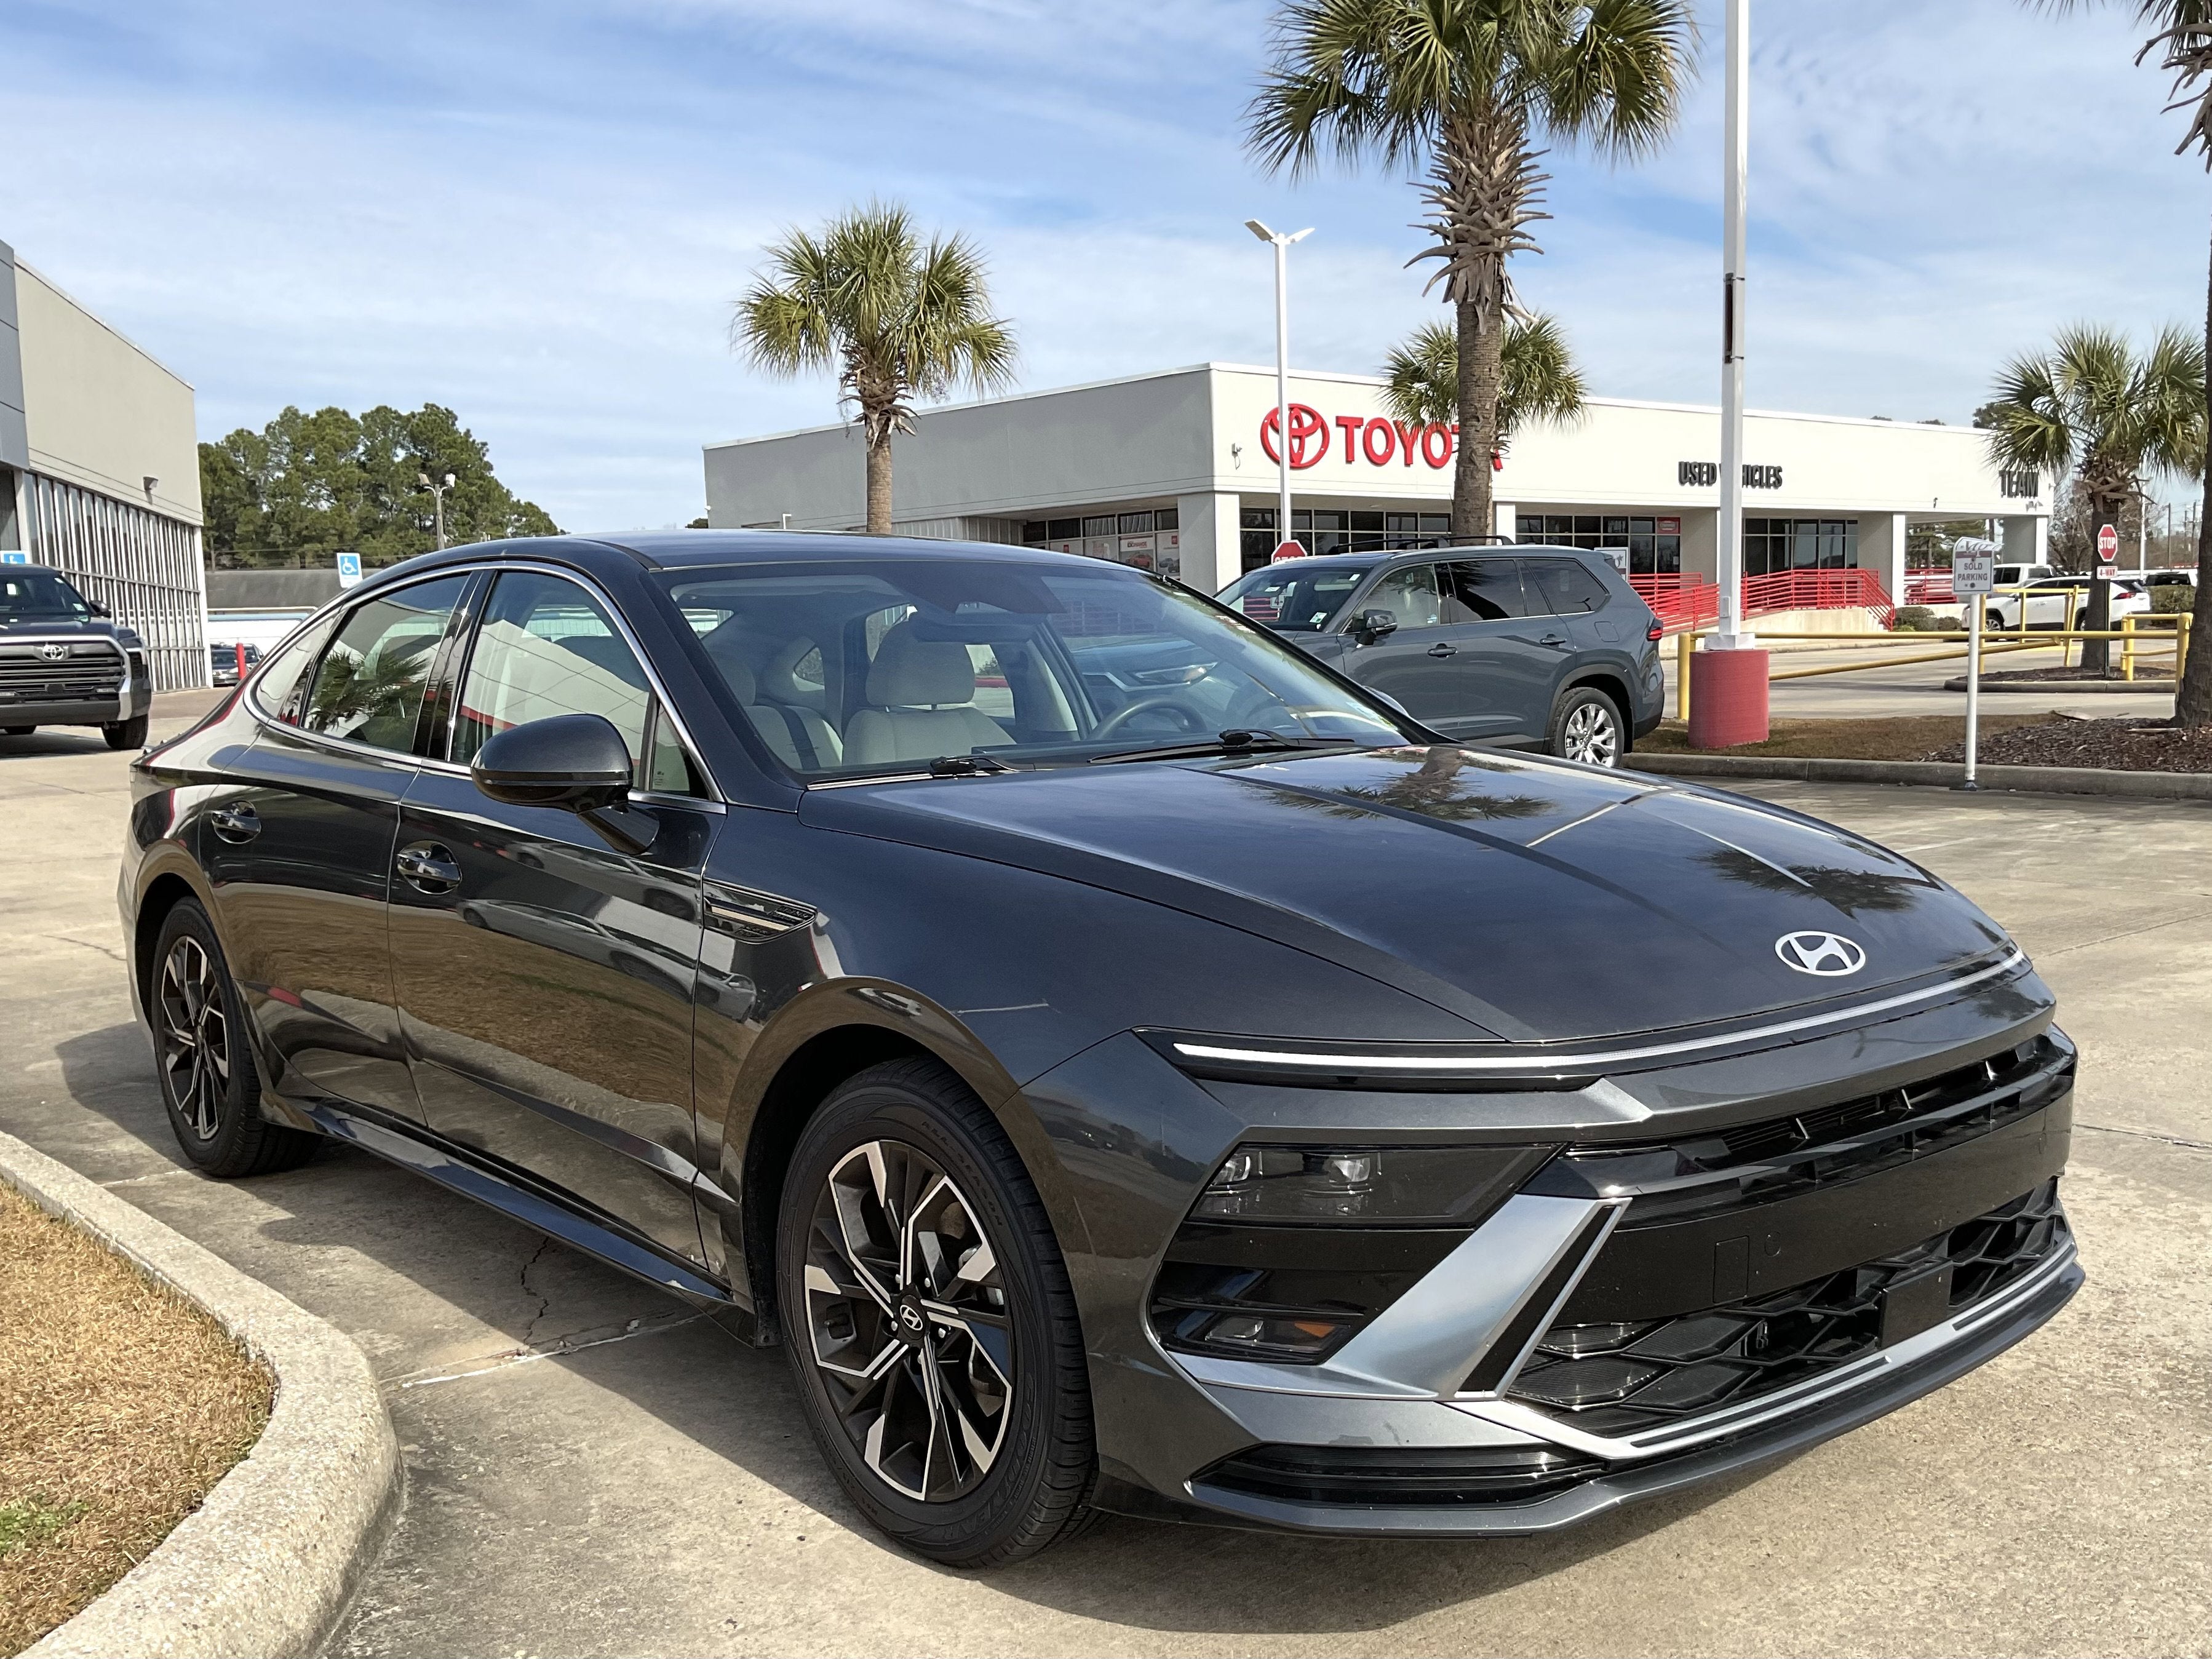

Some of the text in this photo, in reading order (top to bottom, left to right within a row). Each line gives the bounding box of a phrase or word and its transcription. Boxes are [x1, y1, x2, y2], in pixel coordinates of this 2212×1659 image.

[1336, 416, 1503, 471] TOYO
[1678, 461, 1783, 490] USED HICLES
[1999, 469, 2039, 498] TEAM
[2099, 536, 2116, 550] STOP
[1957, 573, 1988, 581] PARKING
[921, 1119, 1003, 1228] ALL-SEASON
[942, 1371, 1034, 1540] GOODYEAR
